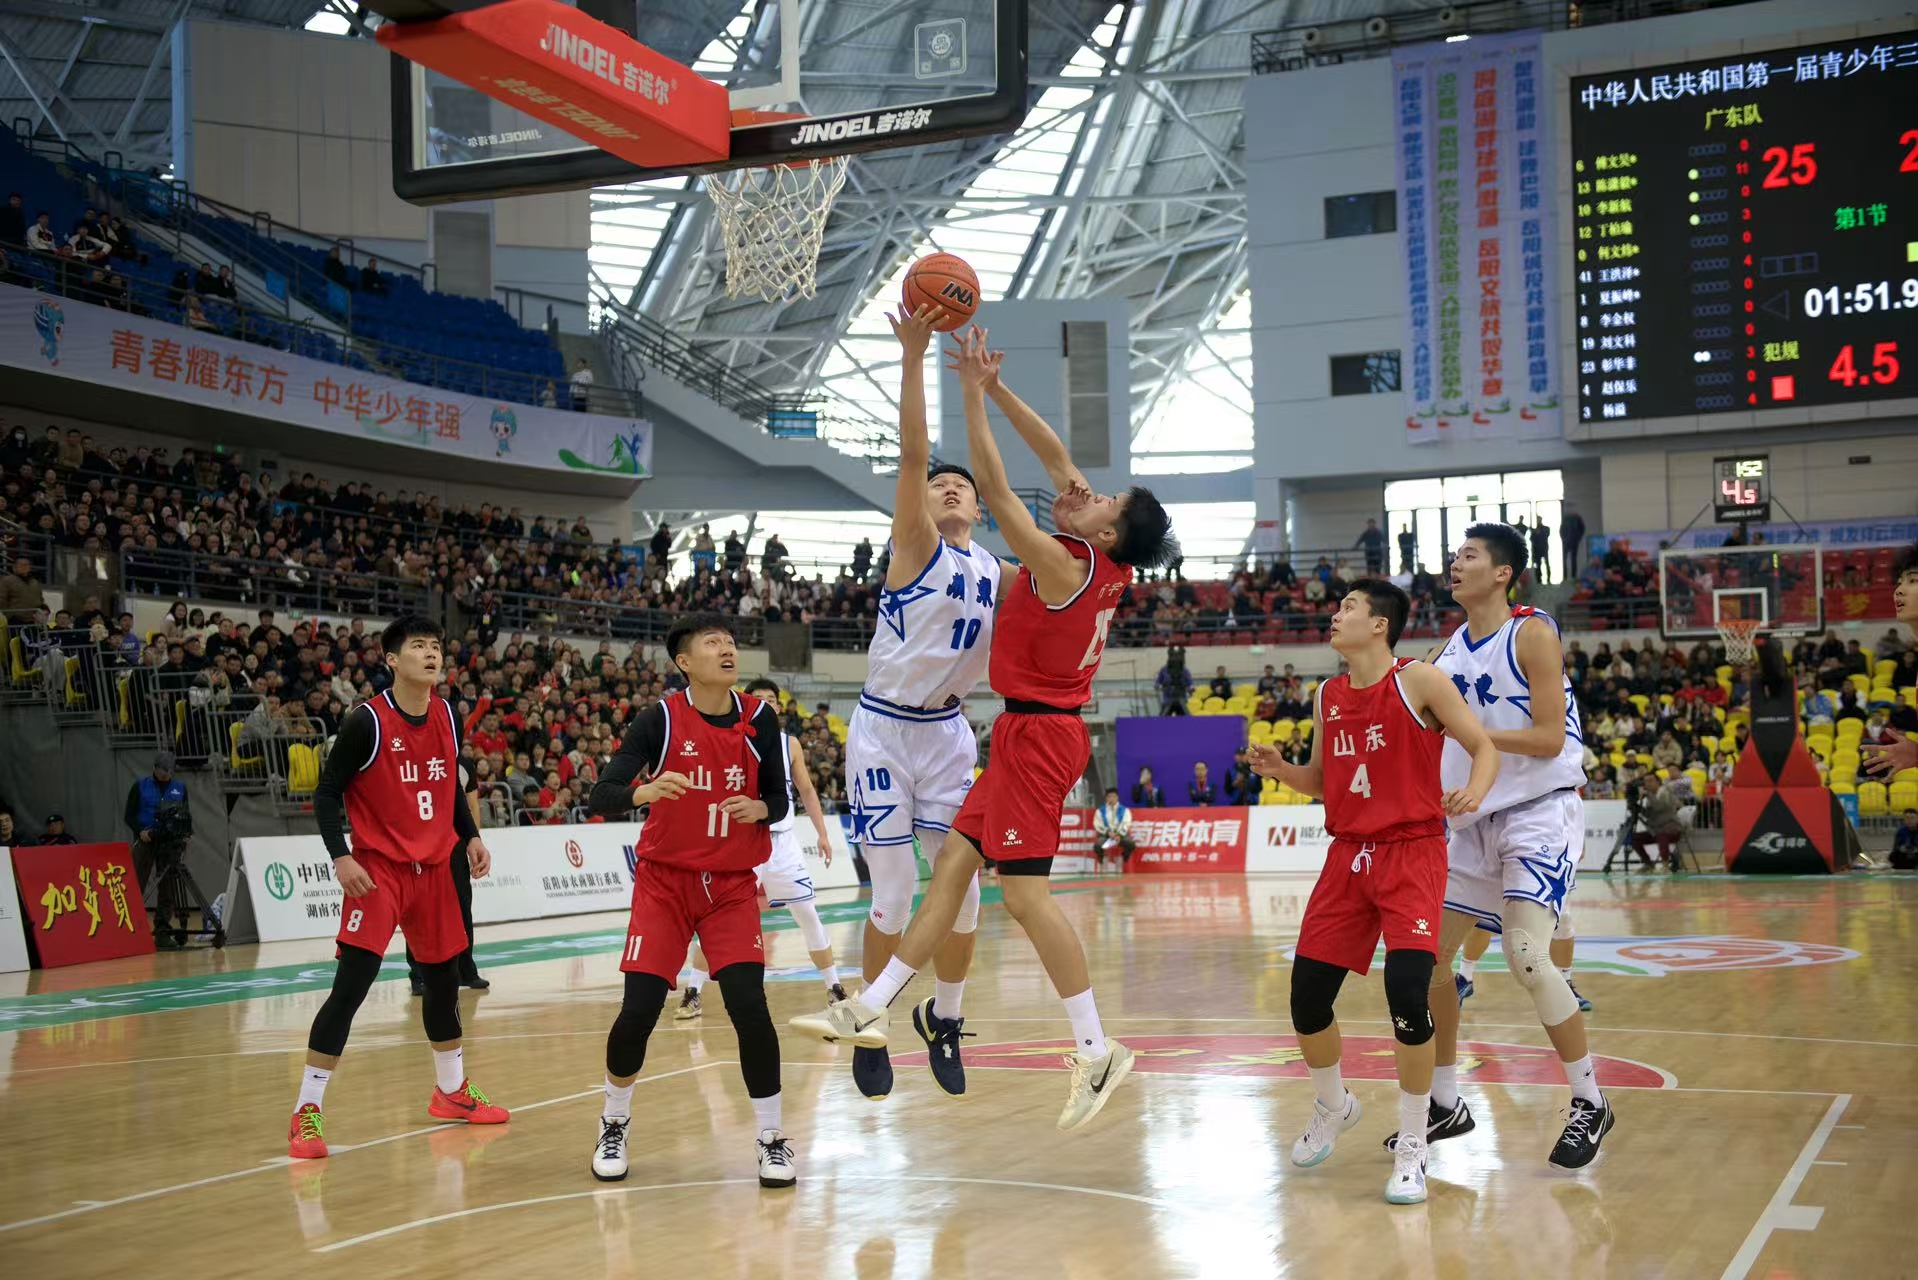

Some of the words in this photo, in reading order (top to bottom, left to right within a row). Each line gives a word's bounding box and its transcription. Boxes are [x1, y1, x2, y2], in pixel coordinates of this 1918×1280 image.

[539, 22, 623, 87] JINOEL
[792, 118, 875, 146] JINOEL
[876, 108, 932, 132] 吉诺尔
[1704, 104, 1763, 131] 广东队
[1761, 143, 1817, 190] 25
[1834, 203, 1888, 231] 第1节
[1804, 279, 1918, 318] 01:51.9
[1828, 341, 1900, 388] 4.5
[110, 329, 288, 405] 青春耀东方
[313, 377, 461, 441] 中华少年强
[1721, 479, 1757, 505] 4.5
[950, 618, 982, 650] 10
[1333, 723, 1387, 757] 山东
[399, 756, 448, 784] 山东
[689, 764, 747, 792] 山东
[865, 767, 891, 791] 10
[1349, 763, 1372, 799] 4
[416, 790, 434, 821] 8
[707, 803, 730, 838] 11
[297, 863, 336, 884] 中国
[305, 902, 341, 918] 湖南省
[347, 909, 363, 932] 8
[626, 935, 642, 961] 11
